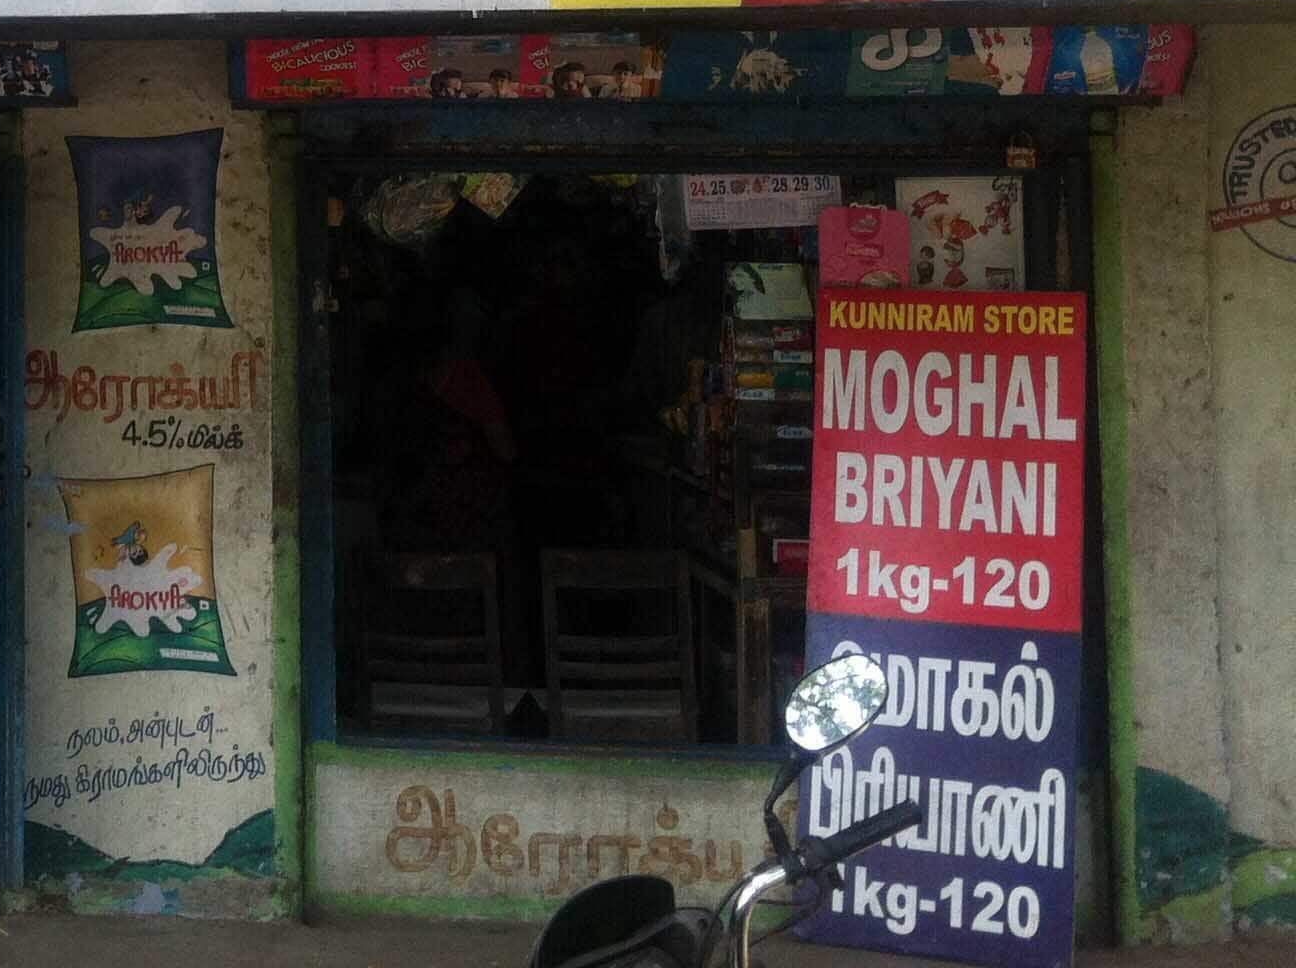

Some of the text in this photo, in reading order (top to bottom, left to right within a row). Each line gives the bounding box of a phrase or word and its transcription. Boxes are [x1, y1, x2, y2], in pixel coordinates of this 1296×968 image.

[271, 40, 354, 72] BICALICIOUS
[112, 240, 183, 264] AROKYA
[829, 300, 1075, 335] KUNNIRAM STORE
[822, 347, 1077, 442] MOGHAL
[834, 451, 1057, 537] BRIYANI
[108, 583, 188, 610] AROKYA
[836, 547, 1051, 614] 1kg-120
